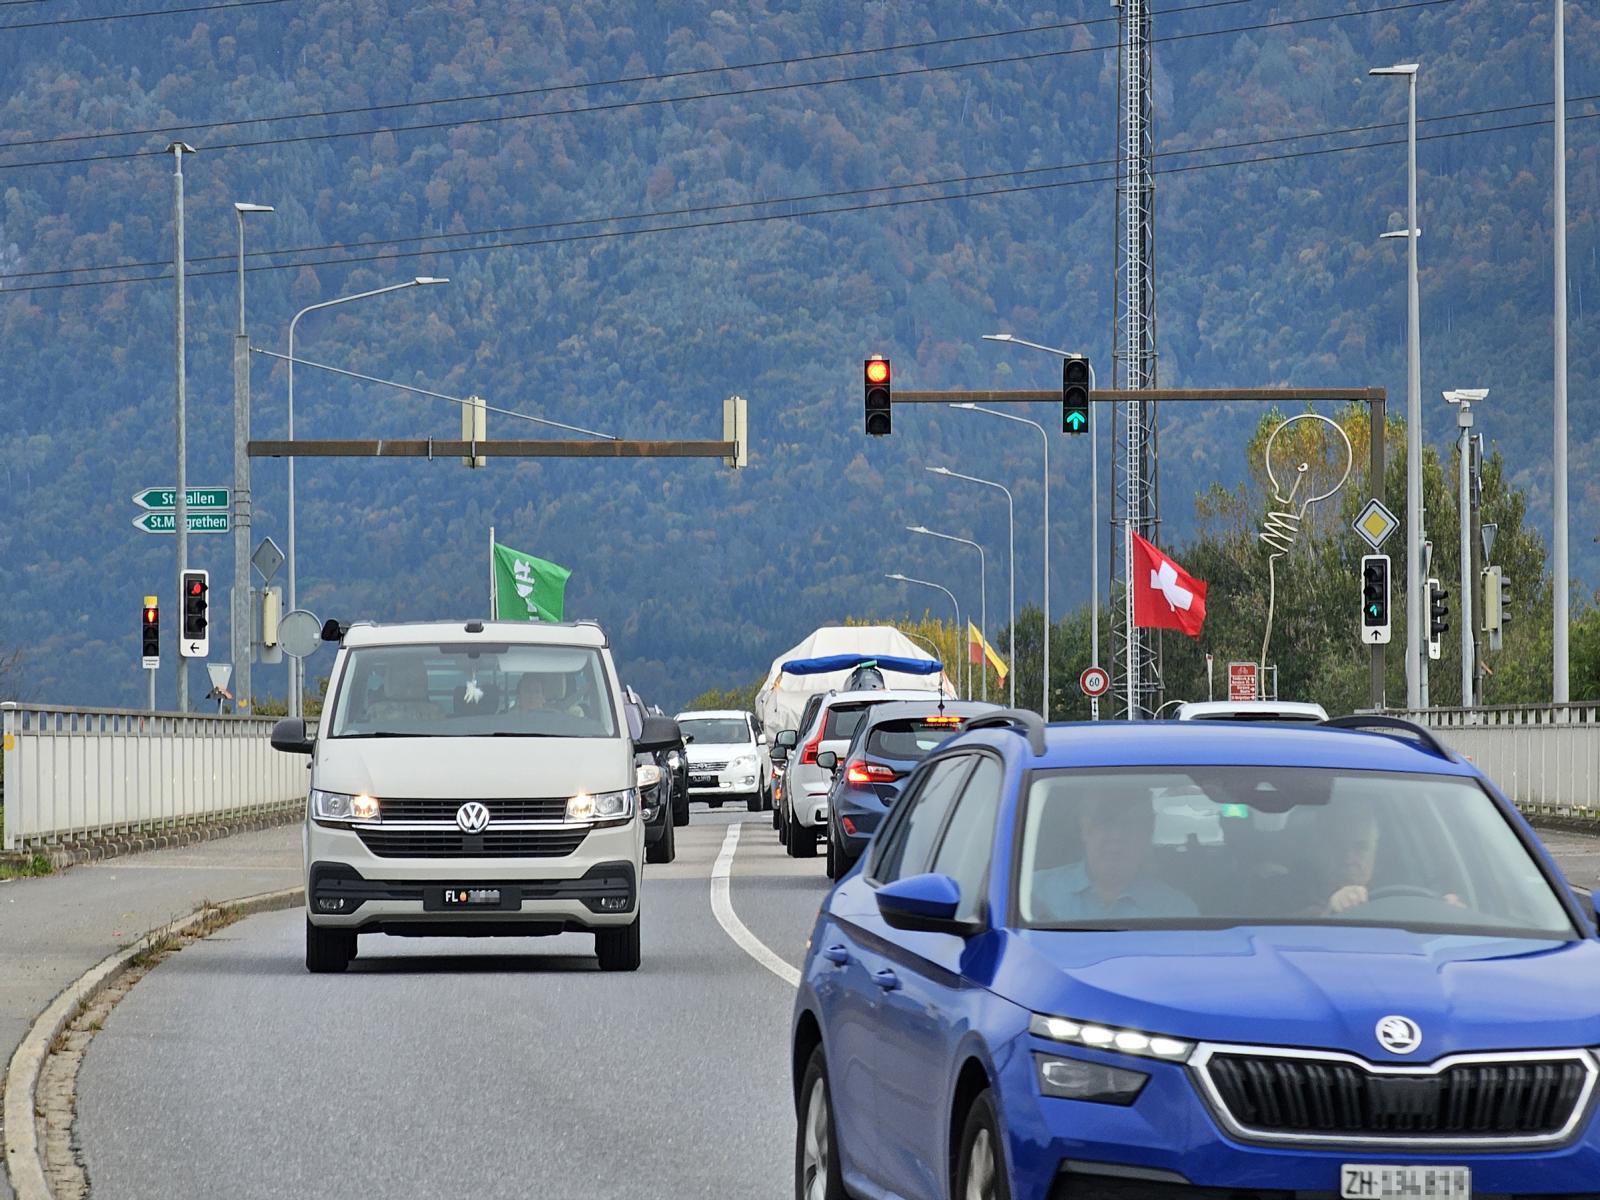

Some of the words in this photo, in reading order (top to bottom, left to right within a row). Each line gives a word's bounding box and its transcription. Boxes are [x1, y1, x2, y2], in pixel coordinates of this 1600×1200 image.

[162, 492, 215, 504] St.allen
[150, 515, 227, 530] St.Mgrethen
[1089, 677, 1100, 687] 60
[445, 890, 459, 903] FL
